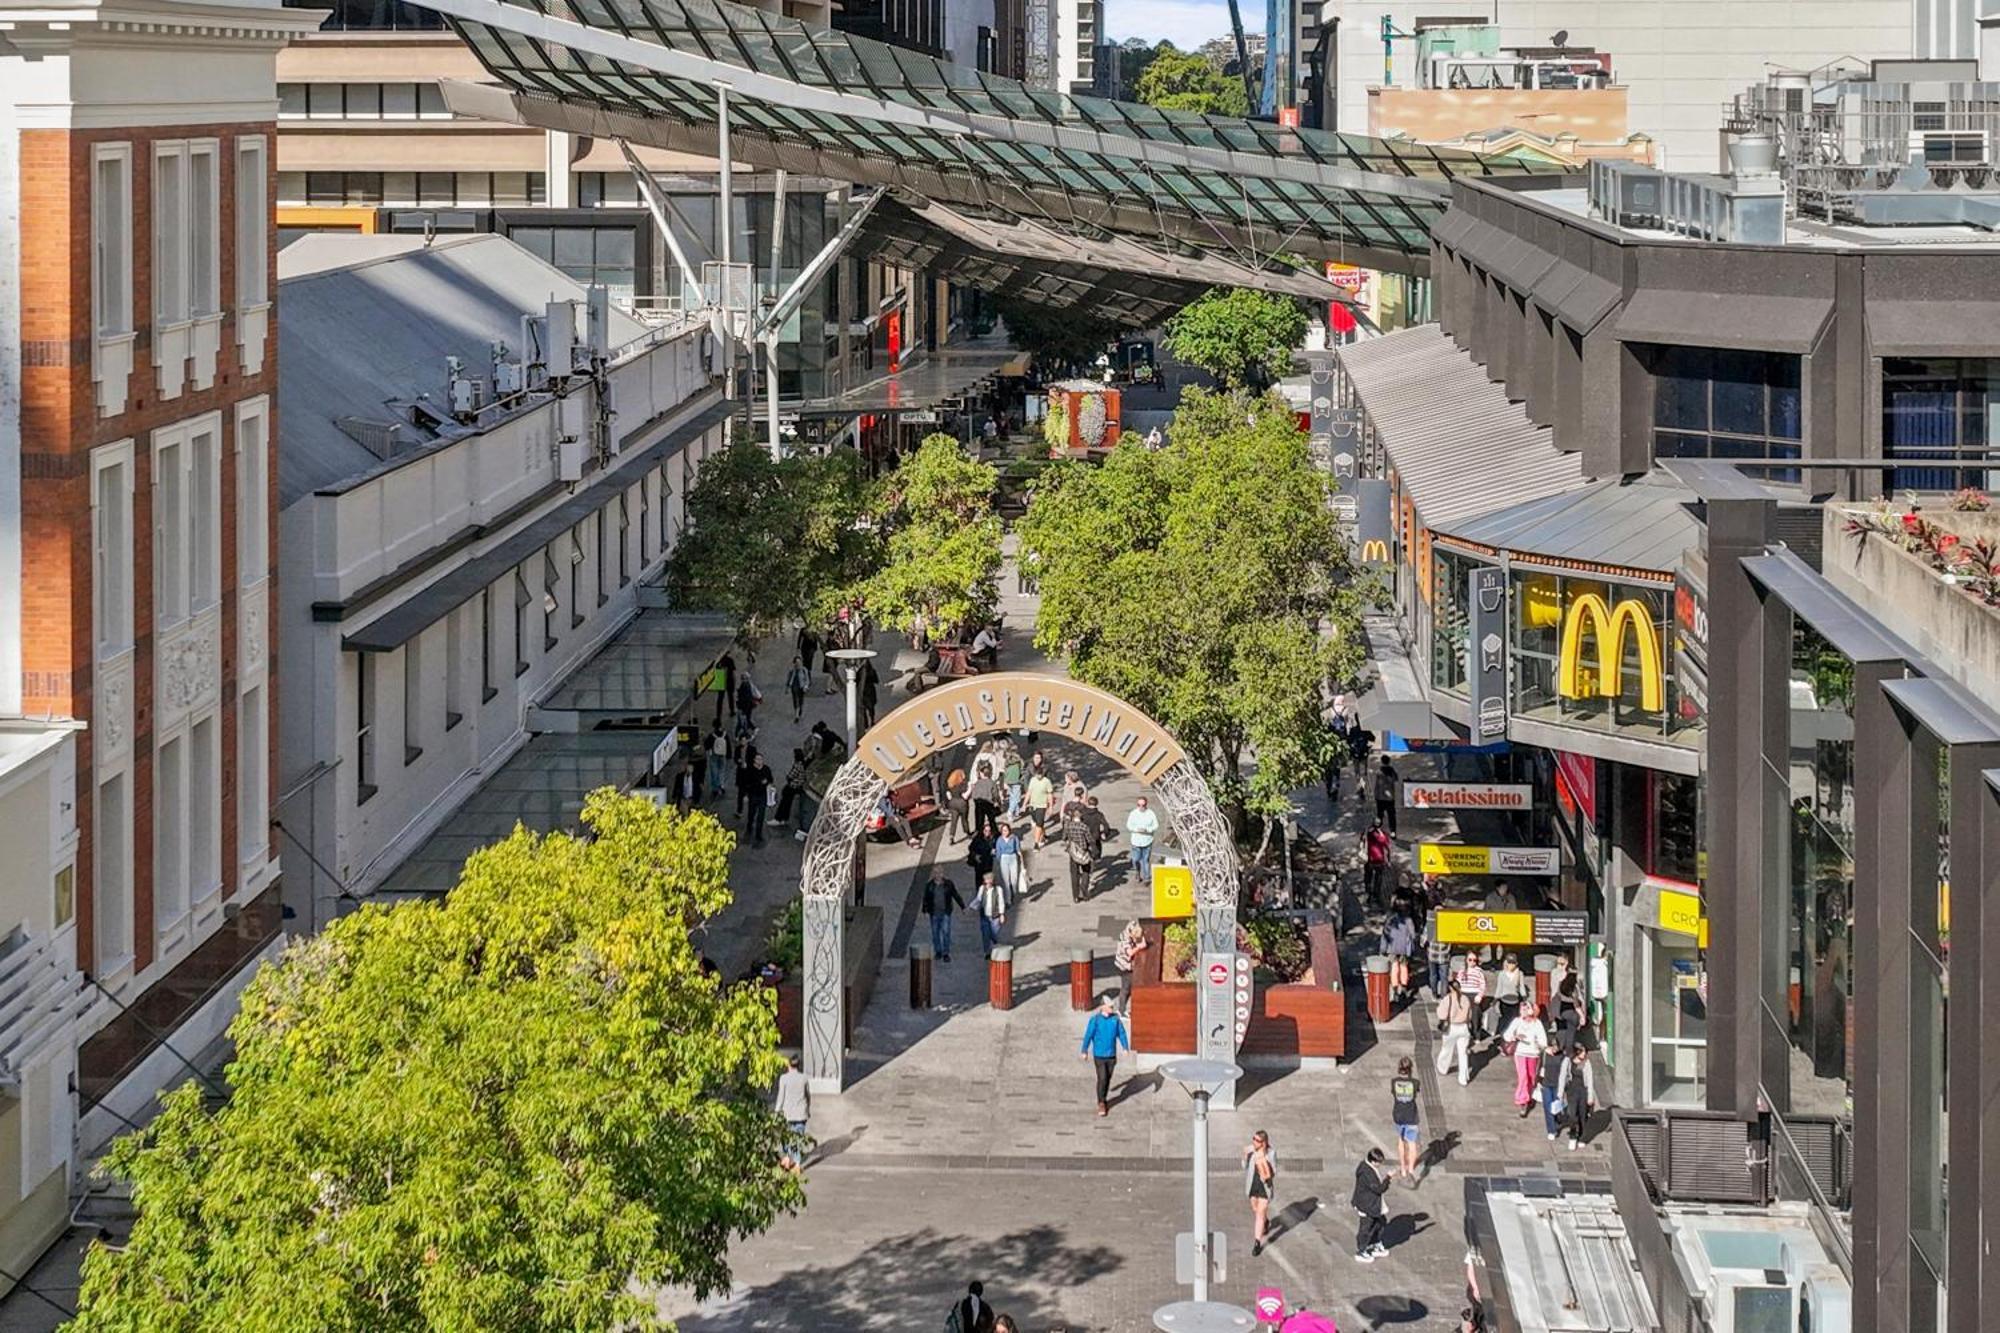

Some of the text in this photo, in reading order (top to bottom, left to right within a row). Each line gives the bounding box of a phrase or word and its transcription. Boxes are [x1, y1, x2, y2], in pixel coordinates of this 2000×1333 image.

[1413, 786, 1523, 806] Gelatissimo
[1443, 853, 1487, 861] CURRENCY
[1468, 916, 1498, 932] SOL
